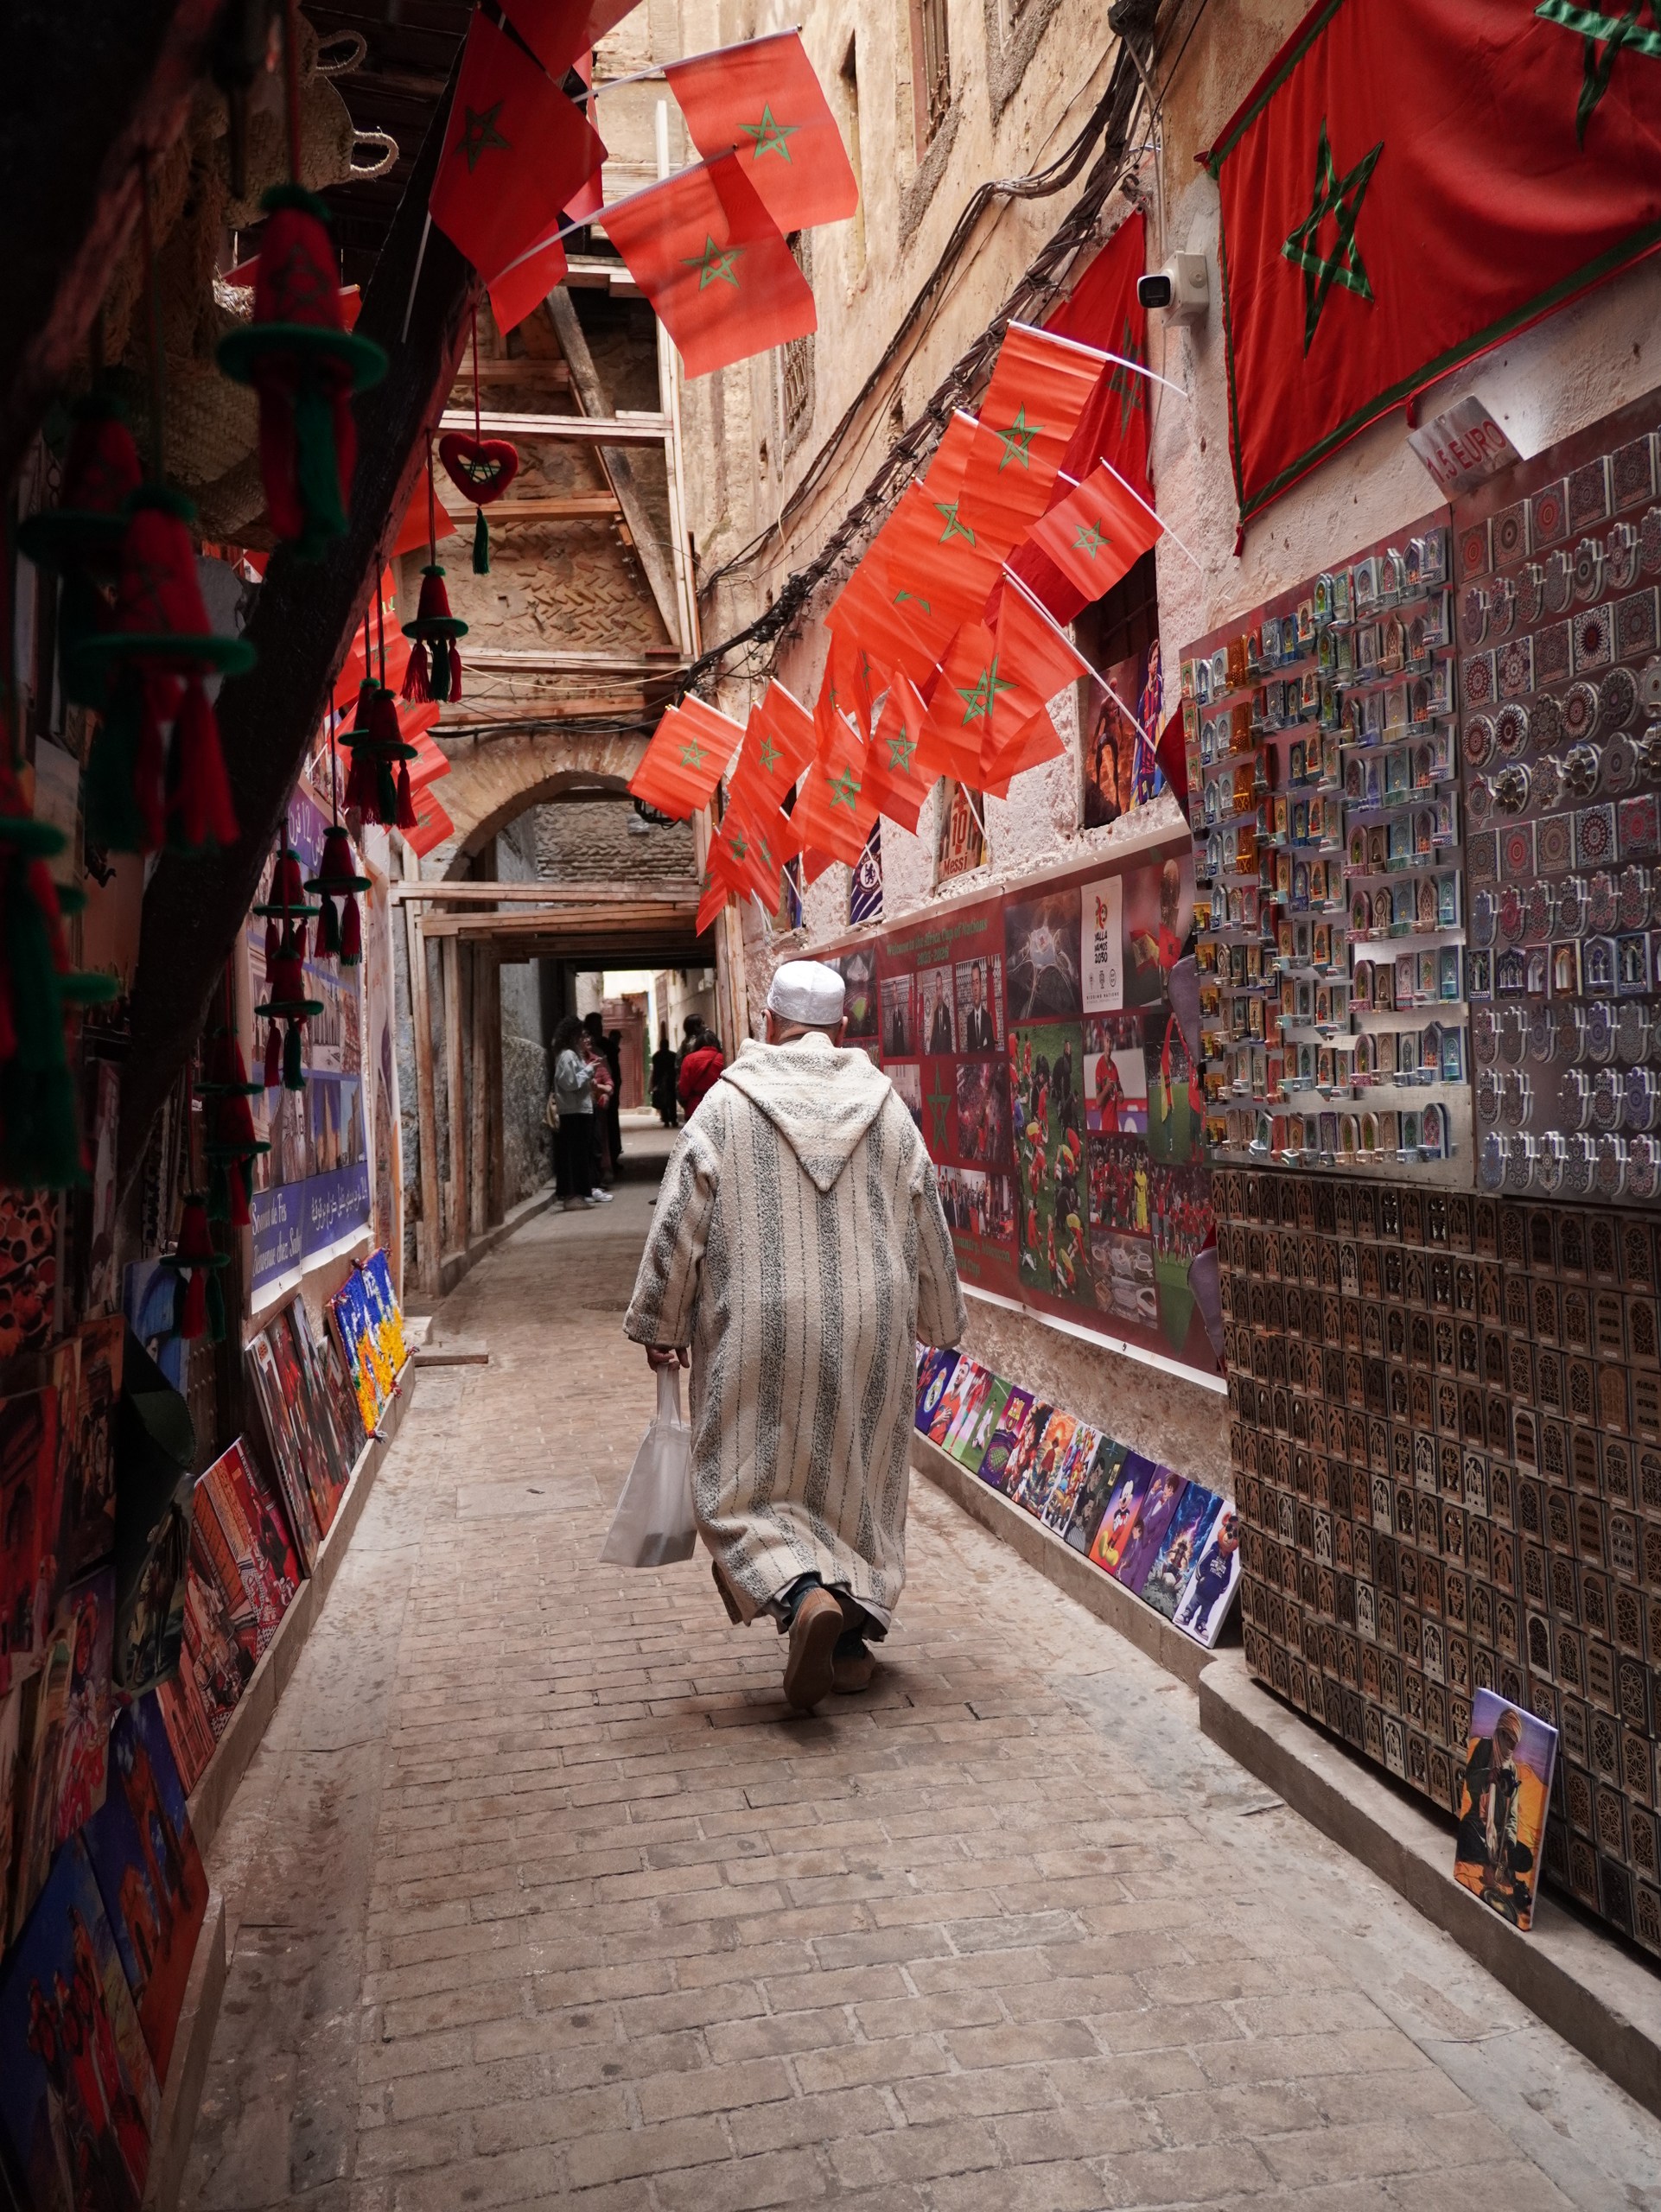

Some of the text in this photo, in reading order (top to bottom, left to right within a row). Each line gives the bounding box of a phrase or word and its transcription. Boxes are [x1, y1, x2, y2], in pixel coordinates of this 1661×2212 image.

[1427, 420, 1506, 483] 1.5 EURO
[951, 809, 968, 847] 10
[943, 851, 968, 877] Messi
[1094, 942, 1108, 952] VAMOS
[1094, 951, 1108, 963] 2030
